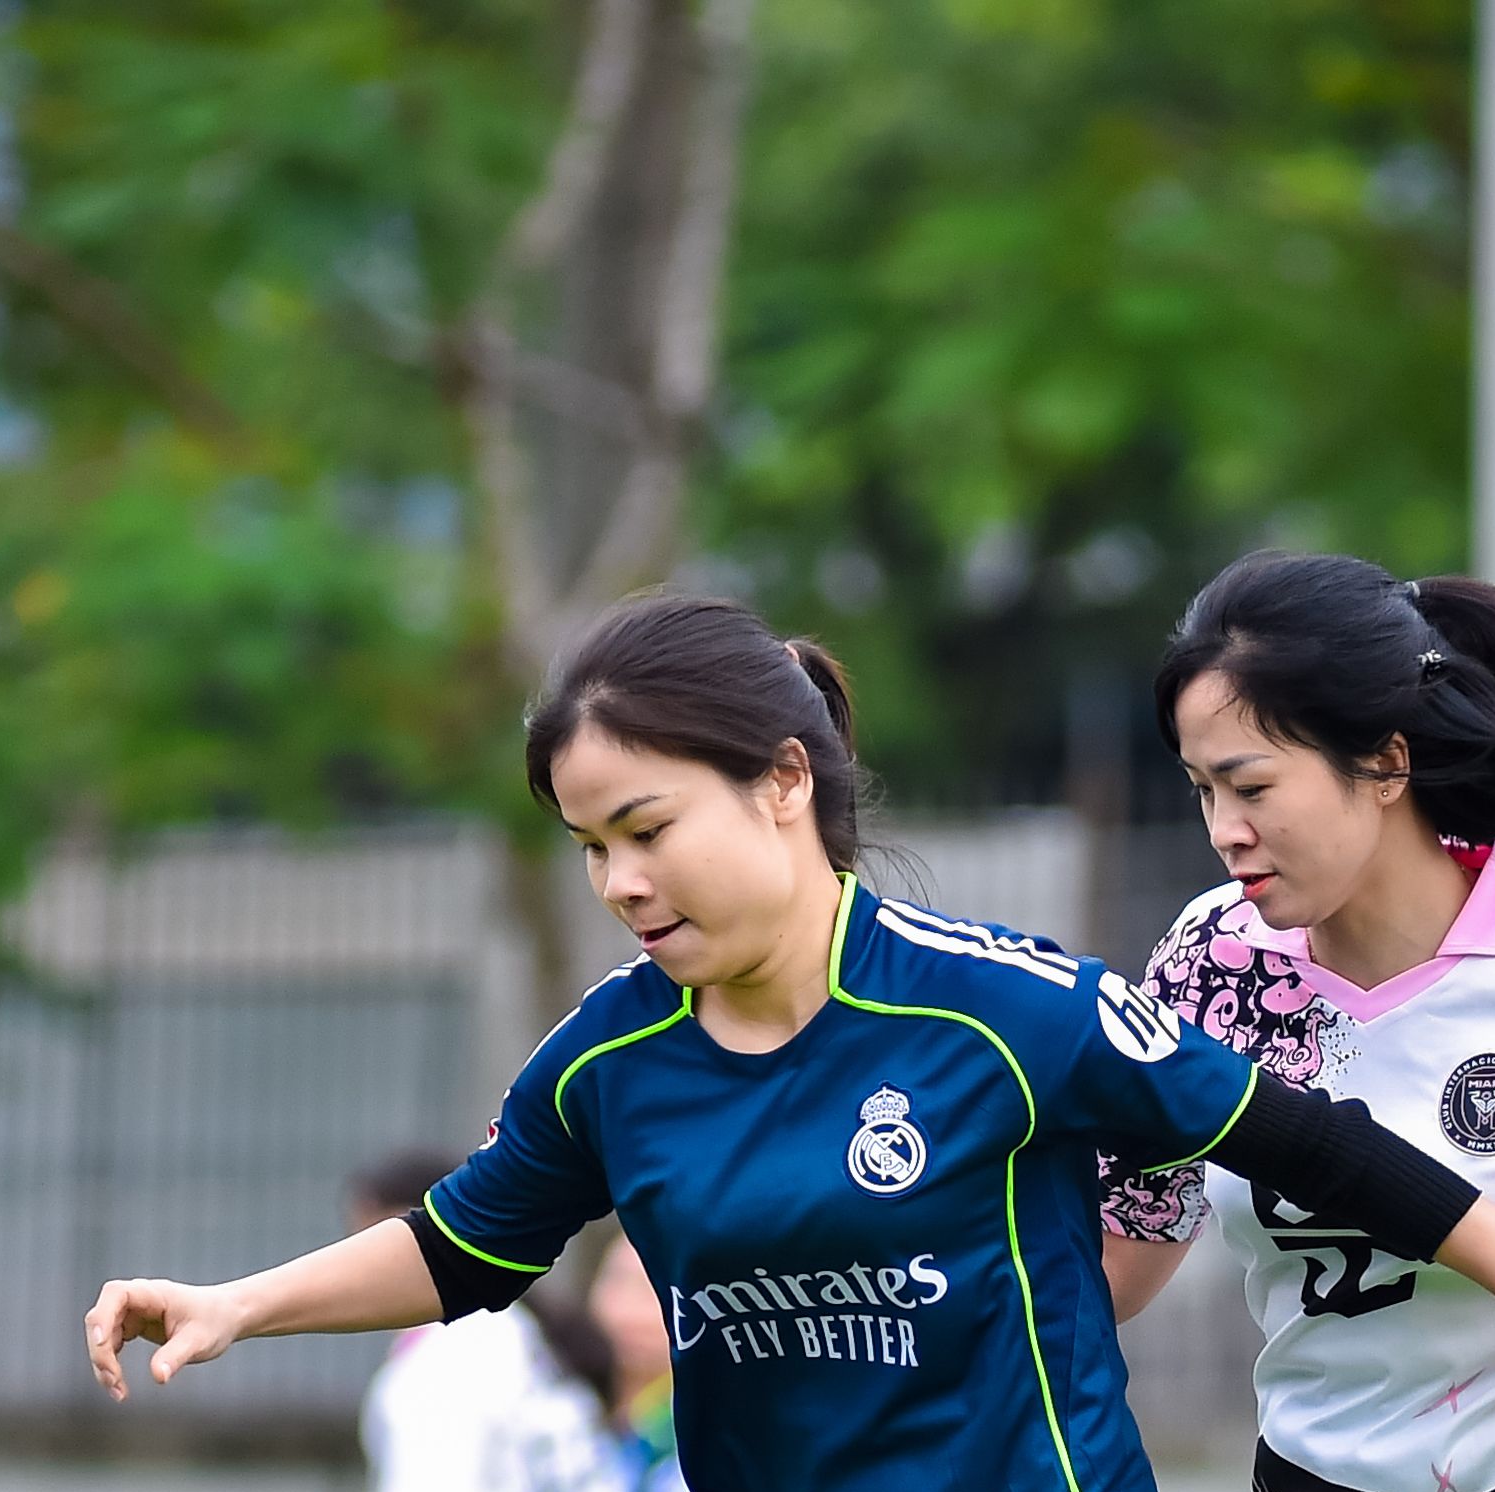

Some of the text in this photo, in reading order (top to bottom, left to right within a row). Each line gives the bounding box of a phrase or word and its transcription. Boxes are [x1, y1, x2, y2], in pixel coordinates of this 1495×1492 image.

[669, 1253, 948, 1351] Emirates
[721, 1314, 919, 1368] FLY BETTER
